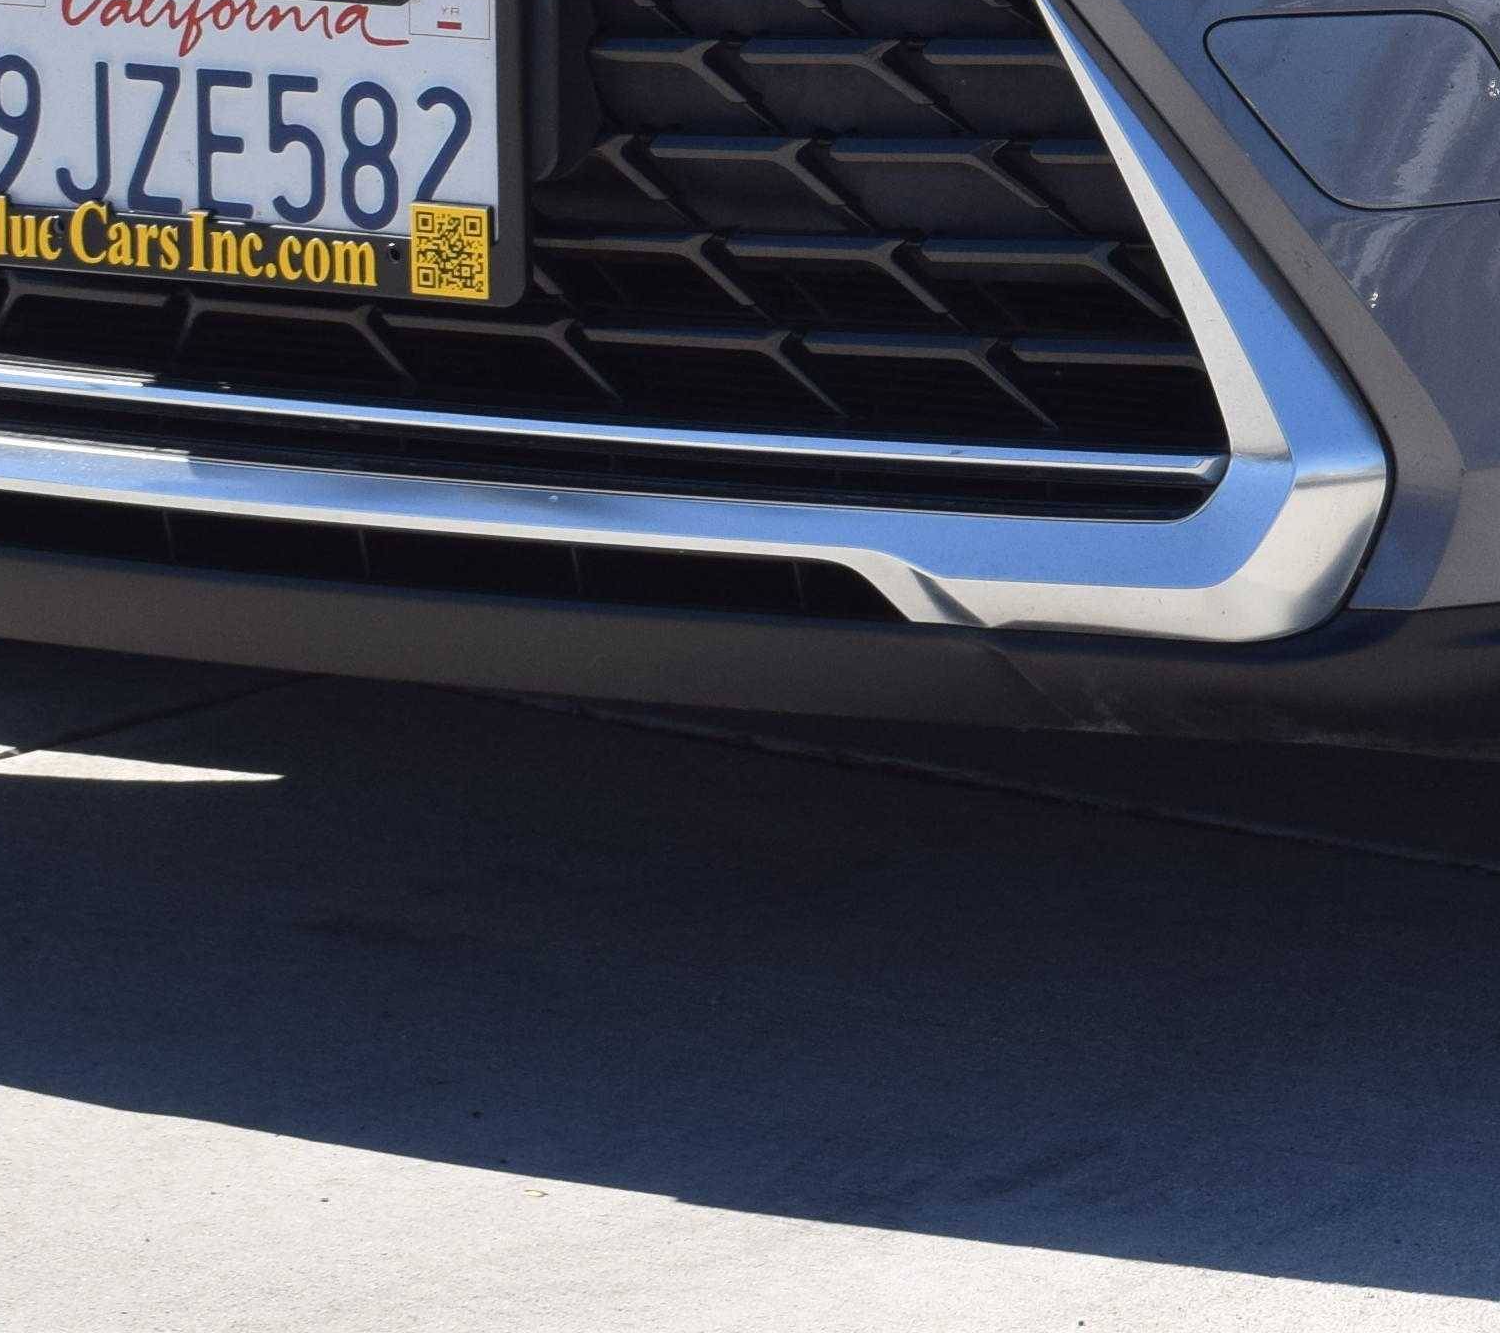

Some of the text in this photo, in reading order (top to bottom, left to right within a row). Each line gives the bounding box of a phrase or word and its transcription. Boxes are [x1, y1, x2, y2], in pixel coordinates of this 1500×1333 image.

[440, 6, 461, 16] YR
[70, 201, 180, 269] Cars
[187, 209, 379, 289] Inc.com
